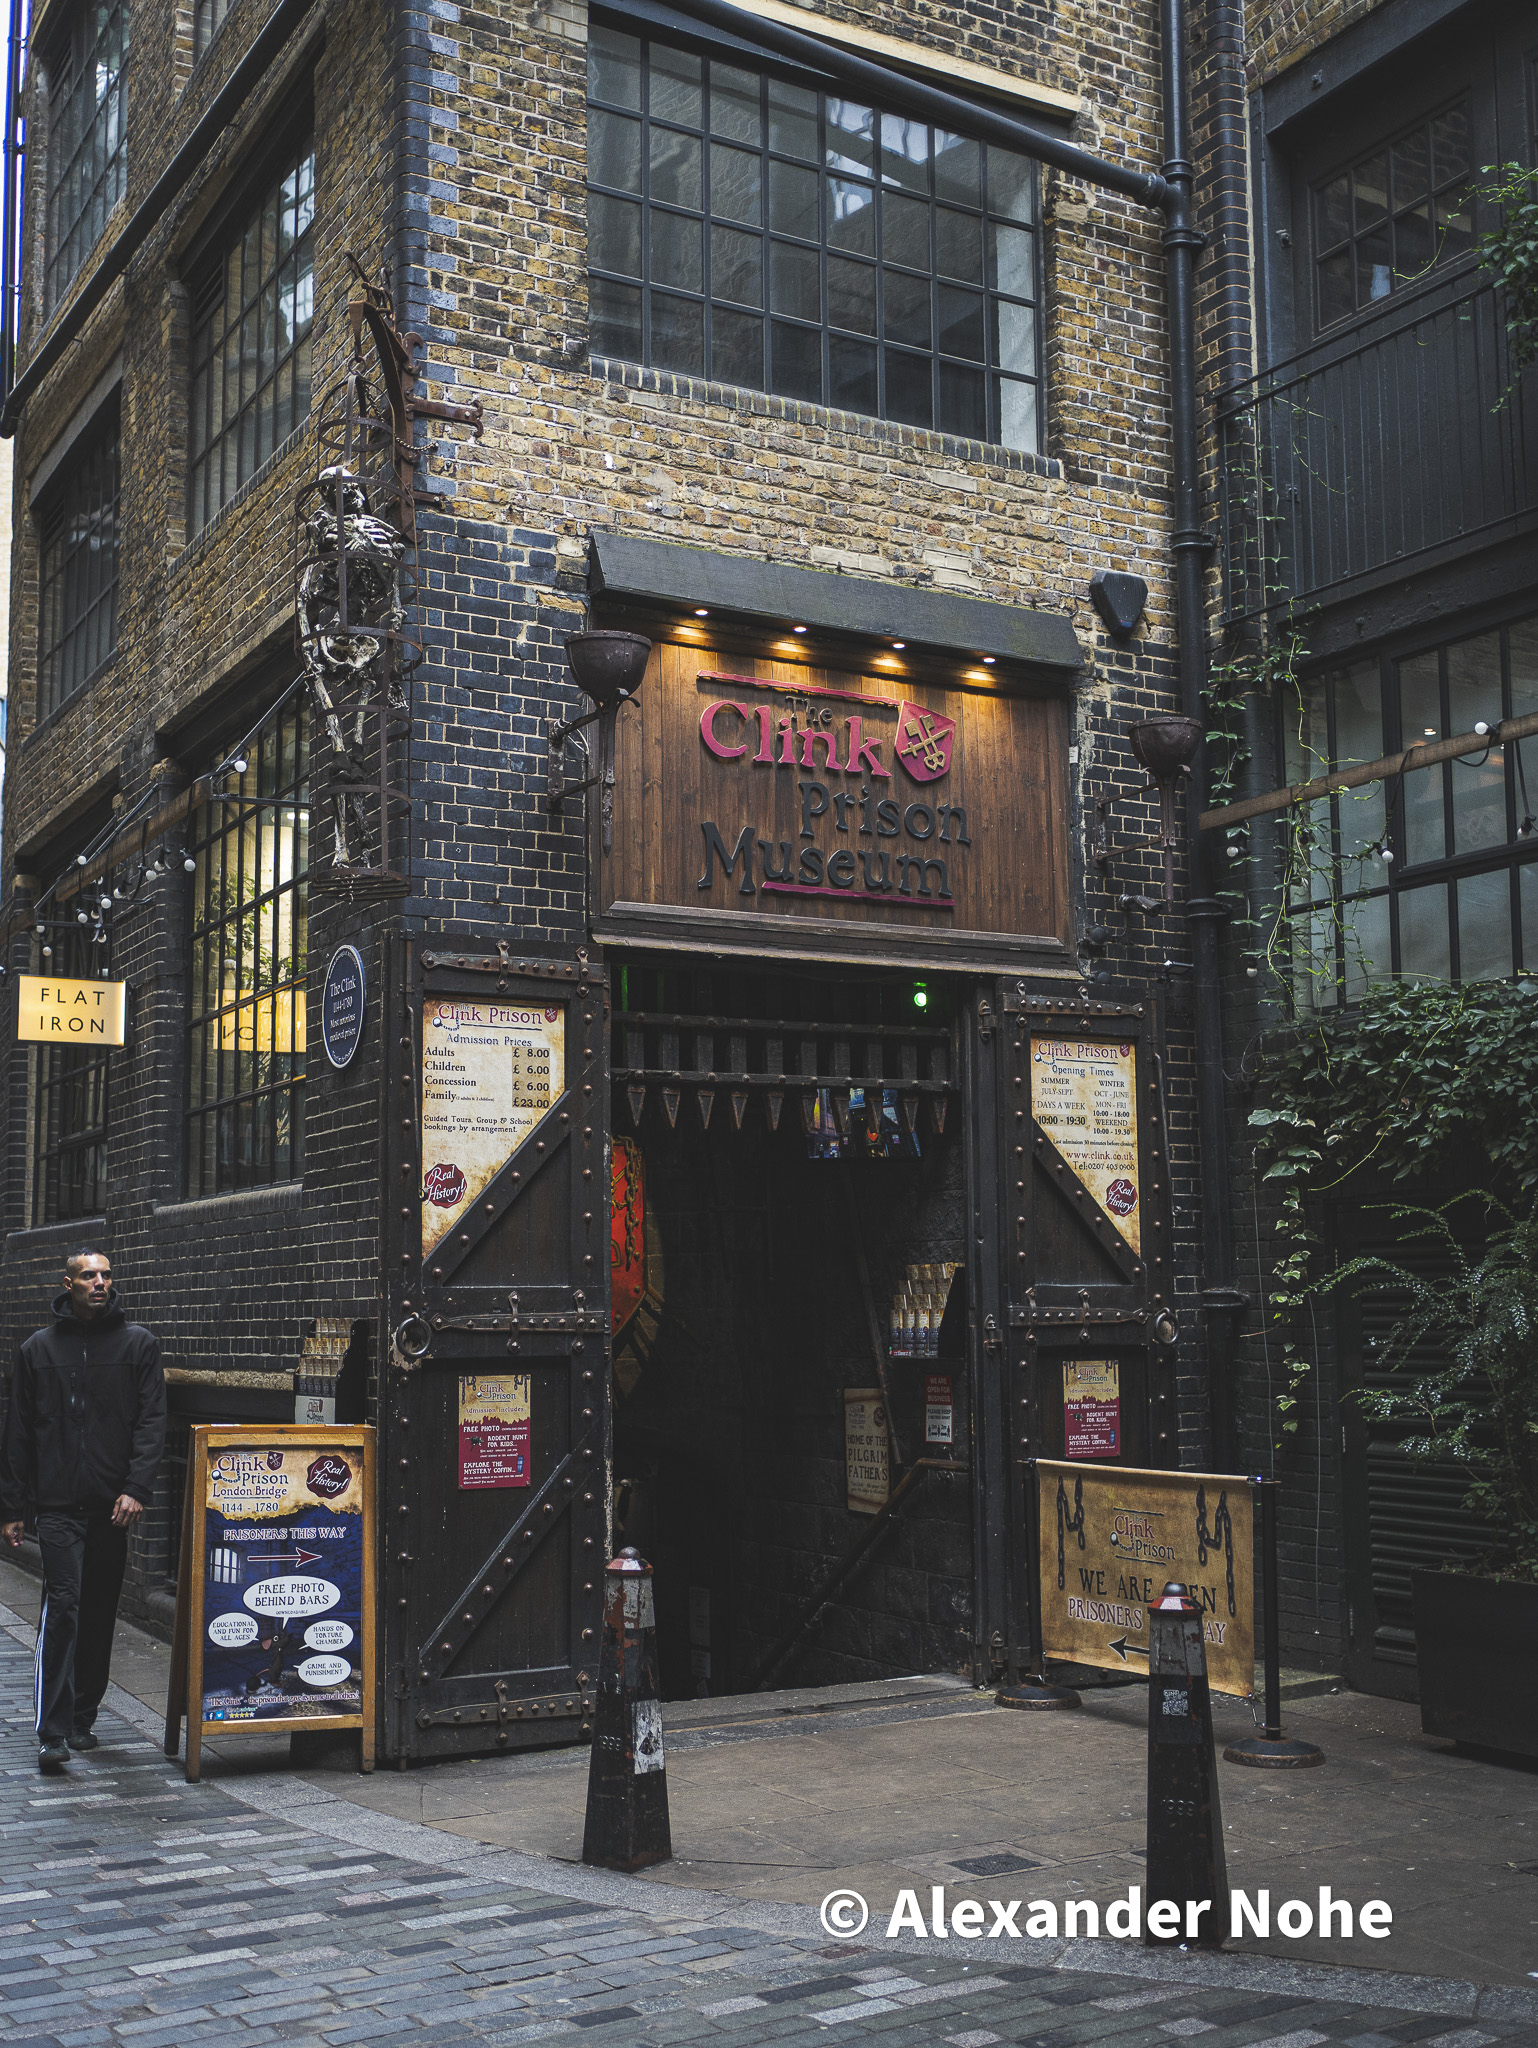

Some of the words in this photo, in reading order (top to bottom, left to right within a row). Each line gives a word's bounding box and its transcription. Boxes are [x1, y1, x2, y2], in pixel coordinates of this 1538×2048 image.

[784, 696, 833, 724] The
[700, 699, 892, 778] Clink
[798, 780, 972, 846] Prison
[697, 821, 954, 897] Museum
[329, 983, 340, 998] The
[340, 974, 356, 994] Clink
[41, 988, 105, 1005] FLAT
[438, 1004, 483, 1022] Clink
[489, 1007, 542, 1025] Prison
[458, 1003, 470, 1011] The
[40, 1016, 104, 1034] IRON
[446, 1034, 499, 1046] Admission
[504, 1036, 532, 1047] Prices
[424, 1047, 455, 1057] Adults
[527, 1049, 550, 1058] 8.00
[1038, 1042, 1072, 1057] Clink
[1077, 1045, 1118, 1059] Prison
[424, 1061, 466, 1072] Children
[527, 1066, 550, 1075] 6.00
[1052, 1065, 1086, 1077] Opening
[1089, 1066, 1114, 1076] Times
[424, 1075, 477, 1087] Concession
[527, 1083, 550, 1092] 6.00
[1041, 1077, 1070, 1085] SUMMER
[1099, 1080, 1125, 1088] WINTER
[424, 1090, 457, 1103] Family
[513, 1099, 550, 1109] £23.00
[1037, 1101, 1056, 1109] DAYS
[1064, 1102, 1085, 1110] WEEK
[424, 1114, 447, 1123] Guided
[476, 1117, 498, 1126] Group
[509, 1118, 533, 1126] School
[1038, 1116, 1058, 1125] 10:00
[1066, 1116, 1086, 1125] 19:30
[424, 1123, 456, 1133] bookings
[459, 1125, 468, 1134] by
[471, 1126, 518, 1134] arrangement.
[1066, 1150, 1135, 1161] www.clink.co.uk
[432, 1164, 455, 1180] Real
[424, 1178, 466, 1204] History!
[1111, 1179, 1134, 1195] Real
[1105, 1191, 1138, 1215] History!
[480, 1384, 504, 1393] Clink
[848, 1435, 864, 1445] HOME
[866, 1436, 874, 1446] OF
[875, 1436, 887, 1446] THE
[848, 1449, 888, 1464] PILGRIM
[217, 1457, 265, 1472] Clink
[322, 1460, 345, 1475] Real
[242, 1473, 289, 1486] Prison
[307, 1470, 347, 1493] History!
[213, 1484, 252, 1497] London
[255, 1486, 287, 1498] Bridge
[221, 1503, 242, 1512] 1144
[255, 1502, 279, 1512] 1780
[224, 1528, 287, 1540] PRISONERS
[289, 1527, 316, 1540] THIS
[318, 1526, 346, 1539] WAY
[1114, 1515, 1155, 1538] Clink
[1134, 1539, 1176, 1560] Prison
[258, 1584, 285, 1594] FREE
[291, 1583, 325, 1593] PHOTO
[1078, 1568, 1107, 1596] WE
[1117, 1574, 1154, 1603] ARE
[255, 1596, 295, 1607] BEHIND
[300, 1595, 329, 1605] BARS
[1068, 1597, 1142, 1630] PRISONERS
[1203, 1621, 1226, 1644] AY
[258, 1695, 276, 1706] prison
